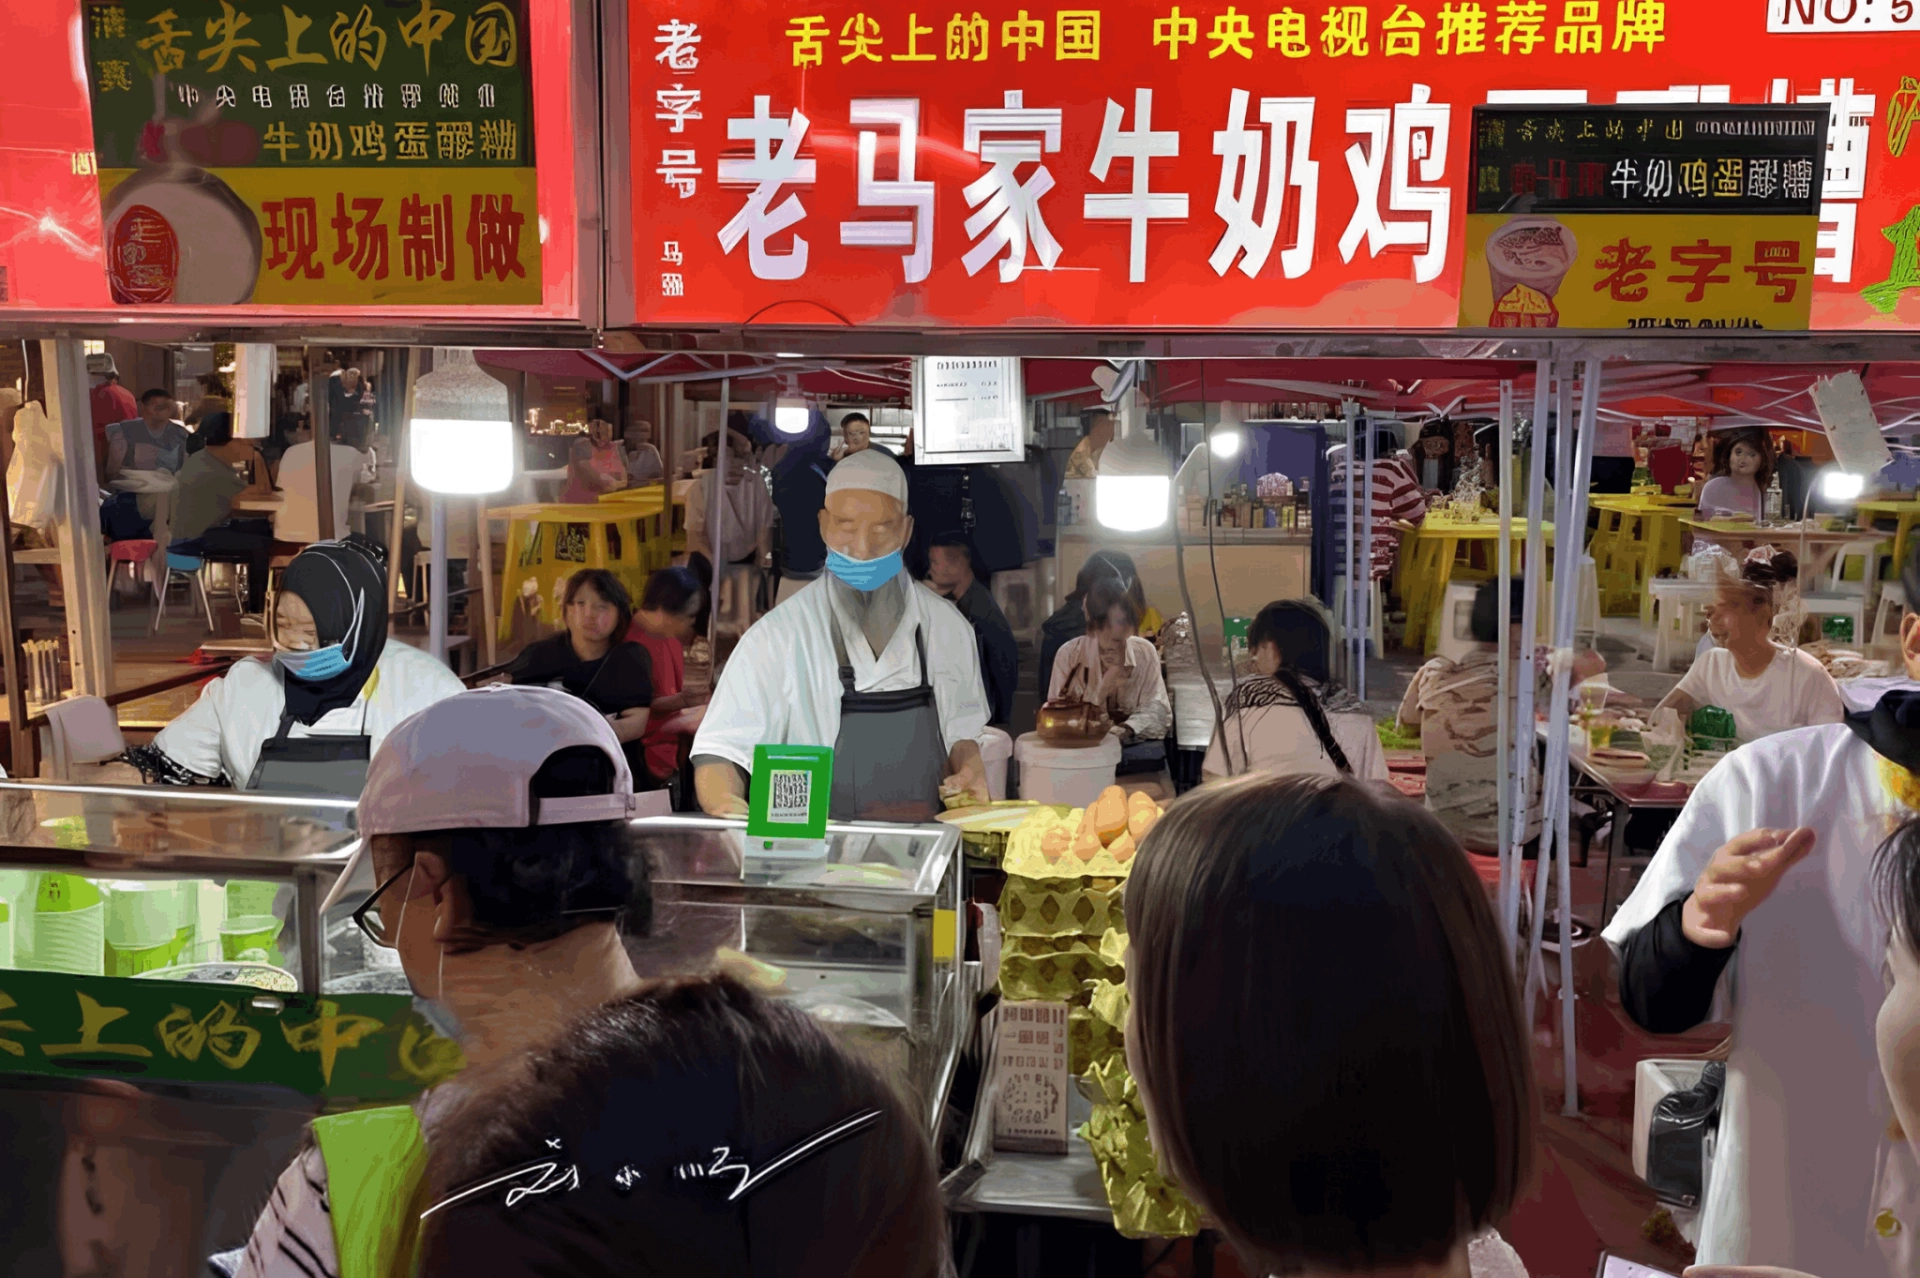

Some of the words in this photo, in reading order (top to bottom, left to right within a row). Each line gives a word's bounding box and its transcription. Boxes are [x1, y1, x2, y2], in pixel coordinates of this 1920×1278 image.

[137, 1, 517, 78] 舌尖上的中国
[785, 10, 1100, 68] 舌尖上的中国
[1153, 0, 1666, 59] 中央电视台推荐品牌
[654, 19, 703, 199] 老字号
[717, 78, 1876, 283] 老马家牛奶鸡
[261, 192, 525, 282] 现场制做
[1593, 237, 1807, 303] 老字号
